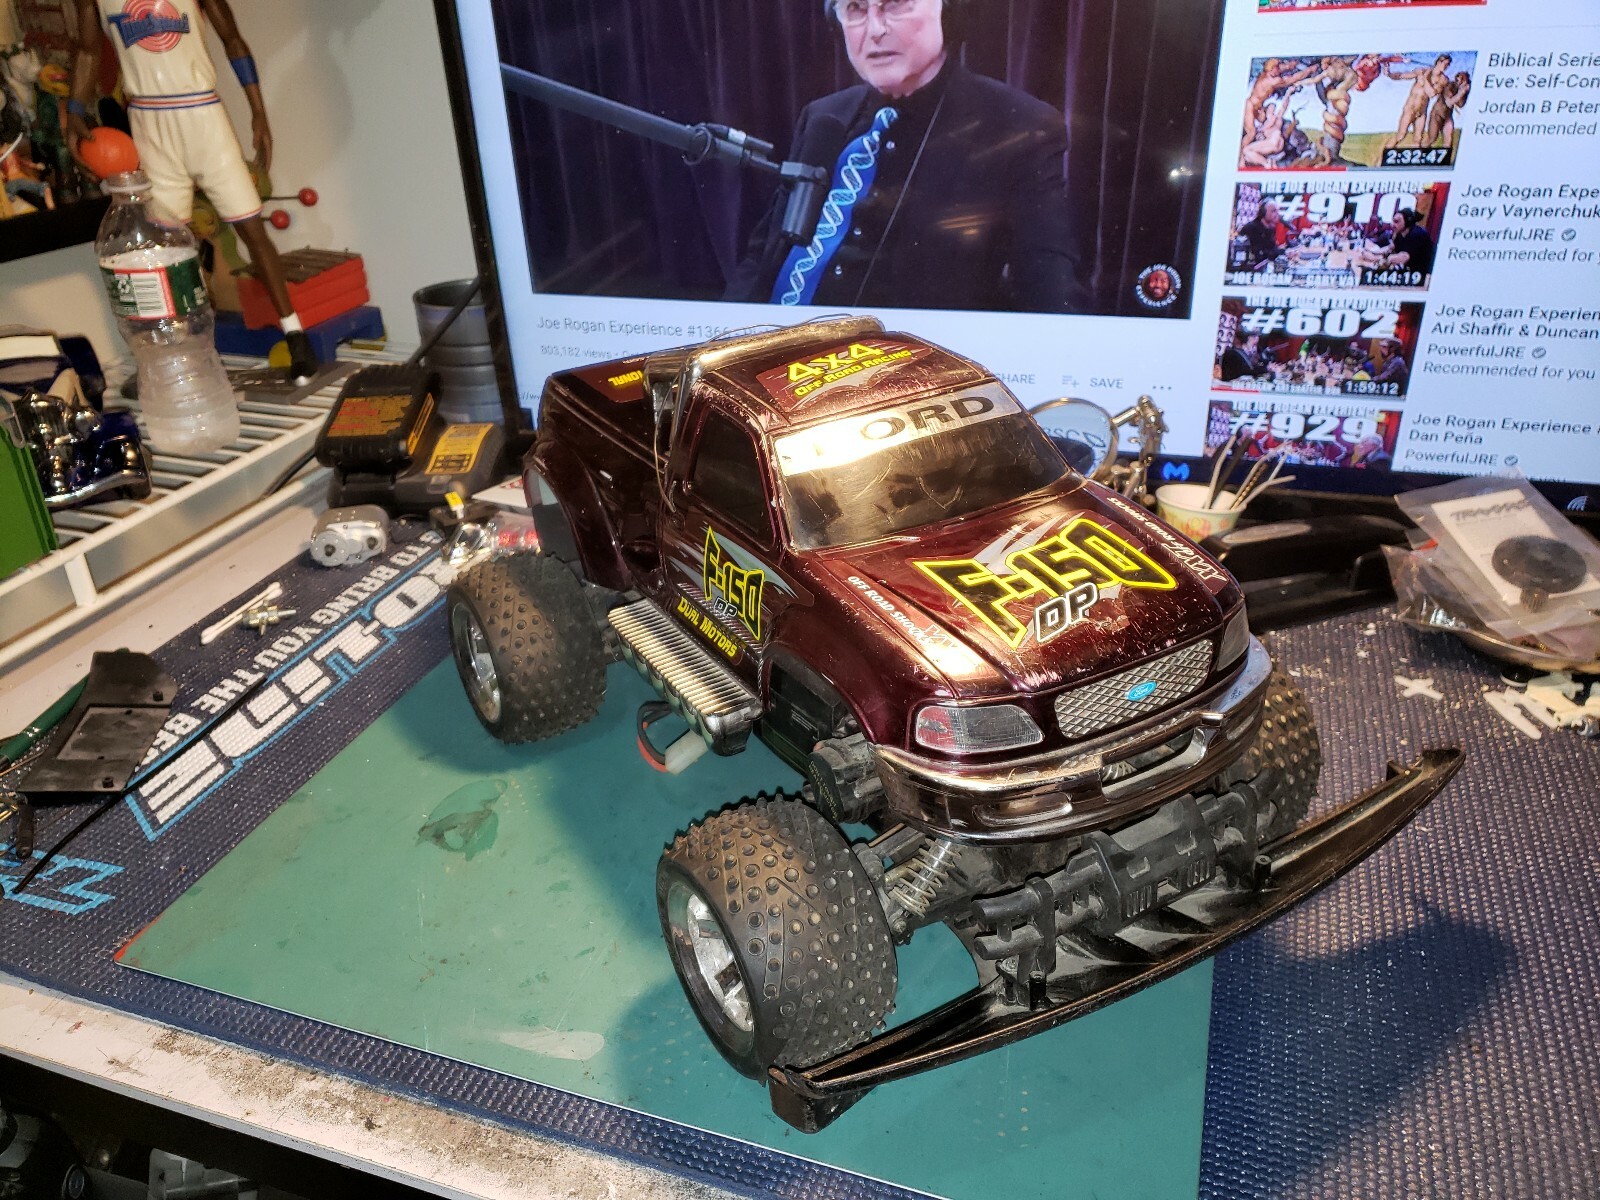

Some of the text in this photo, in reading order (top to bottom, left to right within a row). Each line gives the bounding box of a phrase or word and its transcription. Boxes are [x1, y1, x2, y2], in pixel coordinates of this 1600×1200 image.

[1488, 52, 1600, 67] Biblical Serie
[1484, 73, 1600, 88] Eve: Self-Con
[1478, 100, 1600, 114] Jordan B Peter
[1474, 121, 1598, 135] Recommended
[1386, 150, 1448, 164] 2:32:47
[1461, 184, 1600, 202] Joe Rogan Expe
[1274, 193, 1417, 224] #910
[1457, 203, 1600, 221] Gary Vaynerchuk
[1452, 227, 1556, 242] PowerfulJRE
[1448, 246, 1594, 262] Recommended for
[1365, 270, 1422, 285] 1:44:19
[1241, 308, 1400, 338] #602
[1435, 304, 1600, 322] Joe Rogan Experien
[537, 316, 560, 330] Joe
[564, 318, 606, 334] Rogan
[610, 320, 682, 336] Experience
[1431, 322, 1599, 339] Ari Shaffir & Duncan
[584, 348, 612, 358] views
[1427, 343, 1526, 359] PowerfulJRE
[788, 344, 884, 382] 4X4
[794, 350, 912, 396] OFF ROAD RACING
[1423, 361, 1596, 381] Recommended for you
[1090, 378, 1124, 389] SAVE
[1346, 381, 1398, 394] 1:59:12
[848, 396, 995, 443] ORD
[1230, 412, 1378, 443] #929
[1412, 414, 1592, 434] Joe Rogan Experience
[1409, 430, 1483, 444] Dan Peña
[1404, 450, 1499, 466] PowerfulJRE
[398, 541, 432, 567] TO
[704, 526, 764, 640] F-150
[912, 518, 1179, 650] F-150
[311, 565, 400, 625] BRING
[714, 597, 738, 617] DP
[848, 576, 870, 590] OFF
[864, 590, 894, 610] ROAD
[890, 611, 932, 645] SHOCKS
[1034, 582, 1100, 643] DP
[678, 597, 738, 657] DUAL MOTORS
[258, 625, 322, 668] YOU
[191, 666, 264, 714] THE
